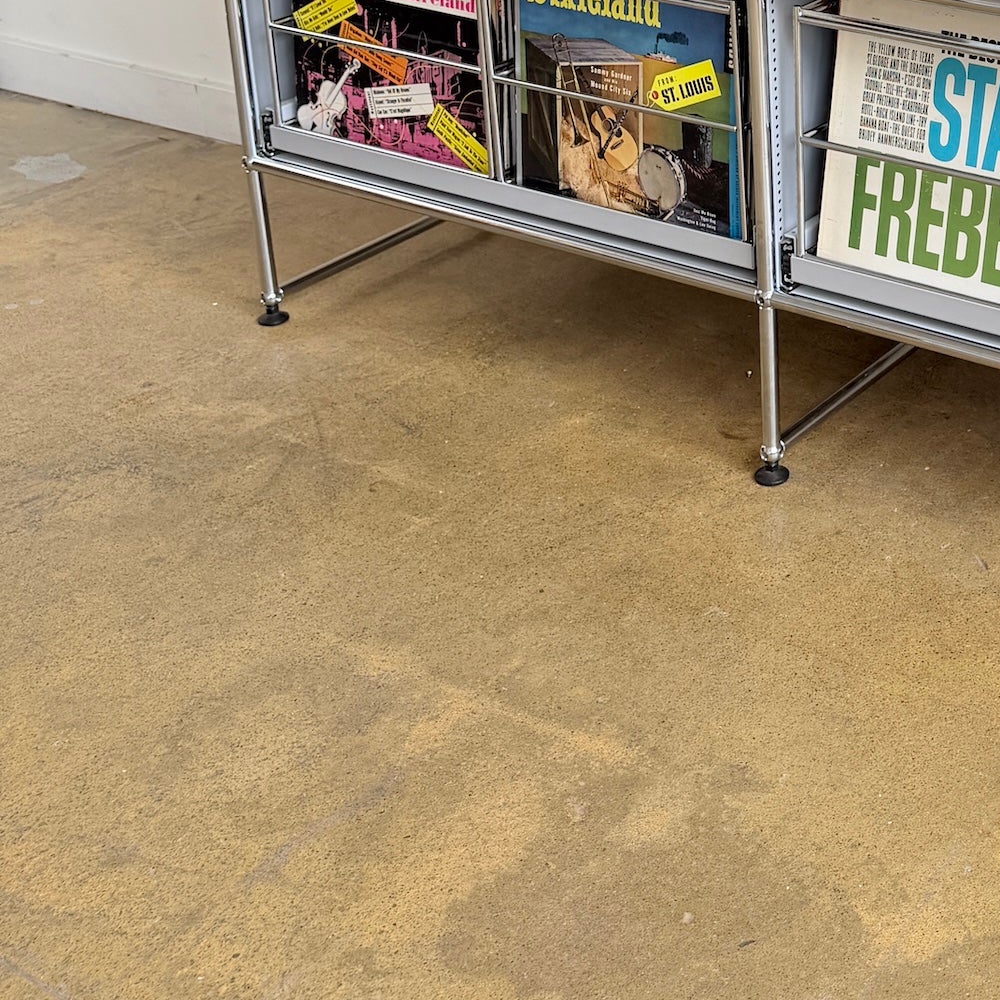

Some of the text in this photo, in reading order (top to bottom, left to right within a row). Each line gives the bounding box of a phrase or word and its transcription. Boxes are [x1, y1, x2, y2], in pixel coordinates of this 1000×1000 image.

[868, 41, 877, 53] THE
[878, 43, 896, 56] YELLOW
[919, 50, 935, 65] TEXAS
[661, 75, 714, 105] ST. LOUIS
